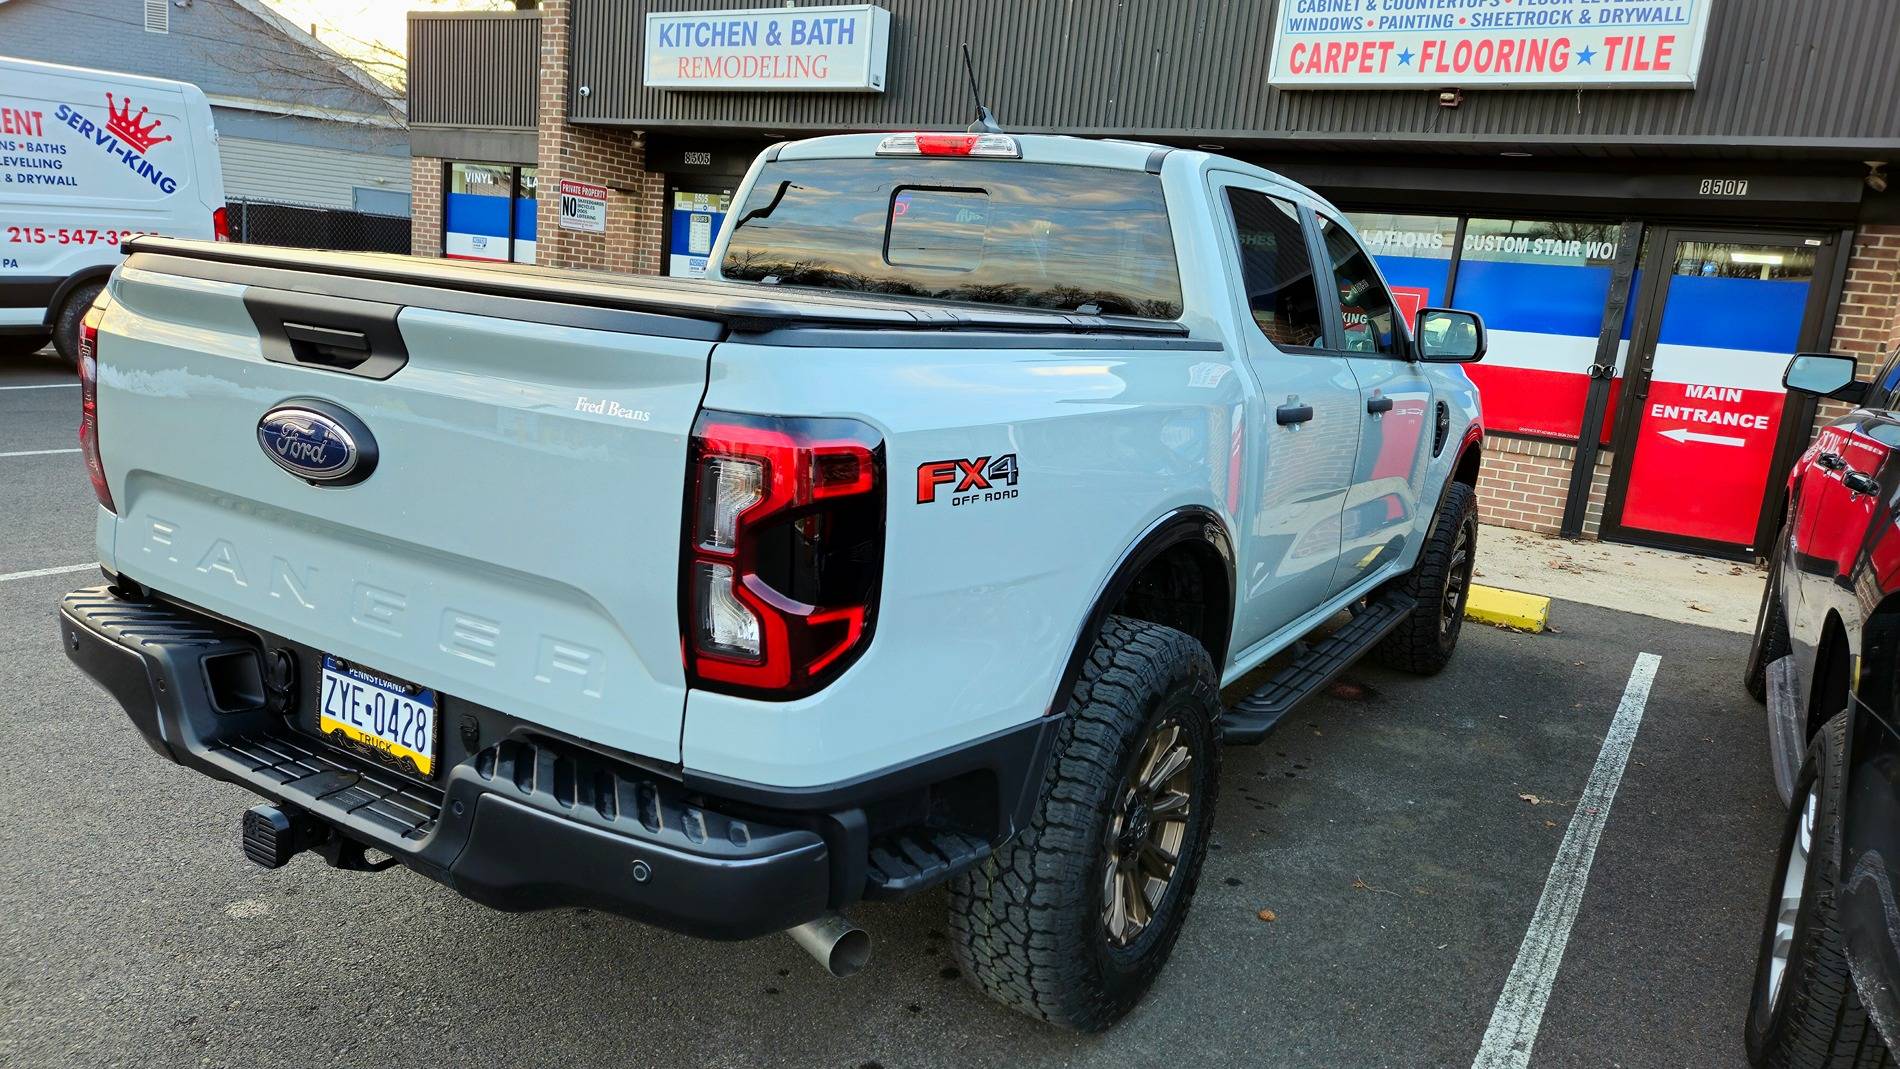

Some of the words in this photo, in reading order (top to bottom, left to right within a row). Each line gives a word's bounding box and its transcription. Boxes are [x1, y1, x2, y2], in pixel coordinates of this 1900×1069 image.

[1297, 0, 1360, 13] CABINET
[1366, 0, 1377, 11] &
[1289, 16, 1363, 32] WINDOWS
[1378, 13, 1453, 30] PAINTING
[1470, 9, 1573, 27] SHEETROCK
[1578, 9, 1591, 25] &
[1600, 7, 1685, 24] DRYWALL
[659, 21, 758, 48] KITCHEN
[765, 20, 782, 46] &
[790, 18, 855, 46] BATH
[1289, 41, 1395, 75] CARPET
[1418, 37, 1571, 74] FLOORING
[1604, 35, 1676, 72] TILE
[677, 54, 829, 80] REMODELING
[0, 108, 43, 137] ENT
[26, 142, 67, 155] BATHS
[54, 104, 177, 195] SERVI-KING
[5, 173, 13, 183] &
[17, 173, 78, 187] DRYWALL
[464, 172, 494, 185] VINYL
[1700, 180, 1747, 195] 8507
[562, 183, 581, 195] PRIVATE
[581, 186, 606, 199] PROPERTY
[562, 196, 577, 217] NO
[7, 226, 160, 246] 215-547-3
[1463, 234, 1528, 254] CUSTOM
[1532, 237, 1582, 258] STAIR
[2, 258, 19, 268] PA
[1685, 384, 1744, 403] MAIN
[574, 396, 607, 415] Fred
[607, 401, 651, 422] Beans
[1651, 403, 1770, 430] ENTRANCE
[275, 422, 327, 464] Ford
[917, 453, 1019, 505] FX4
[952, 494, 980, 507] OFF
[984, 489, 1019, 502] ROAD
[140, 514, 606, 700] RANGER
[358, 731, 392, 753] TRUCK
